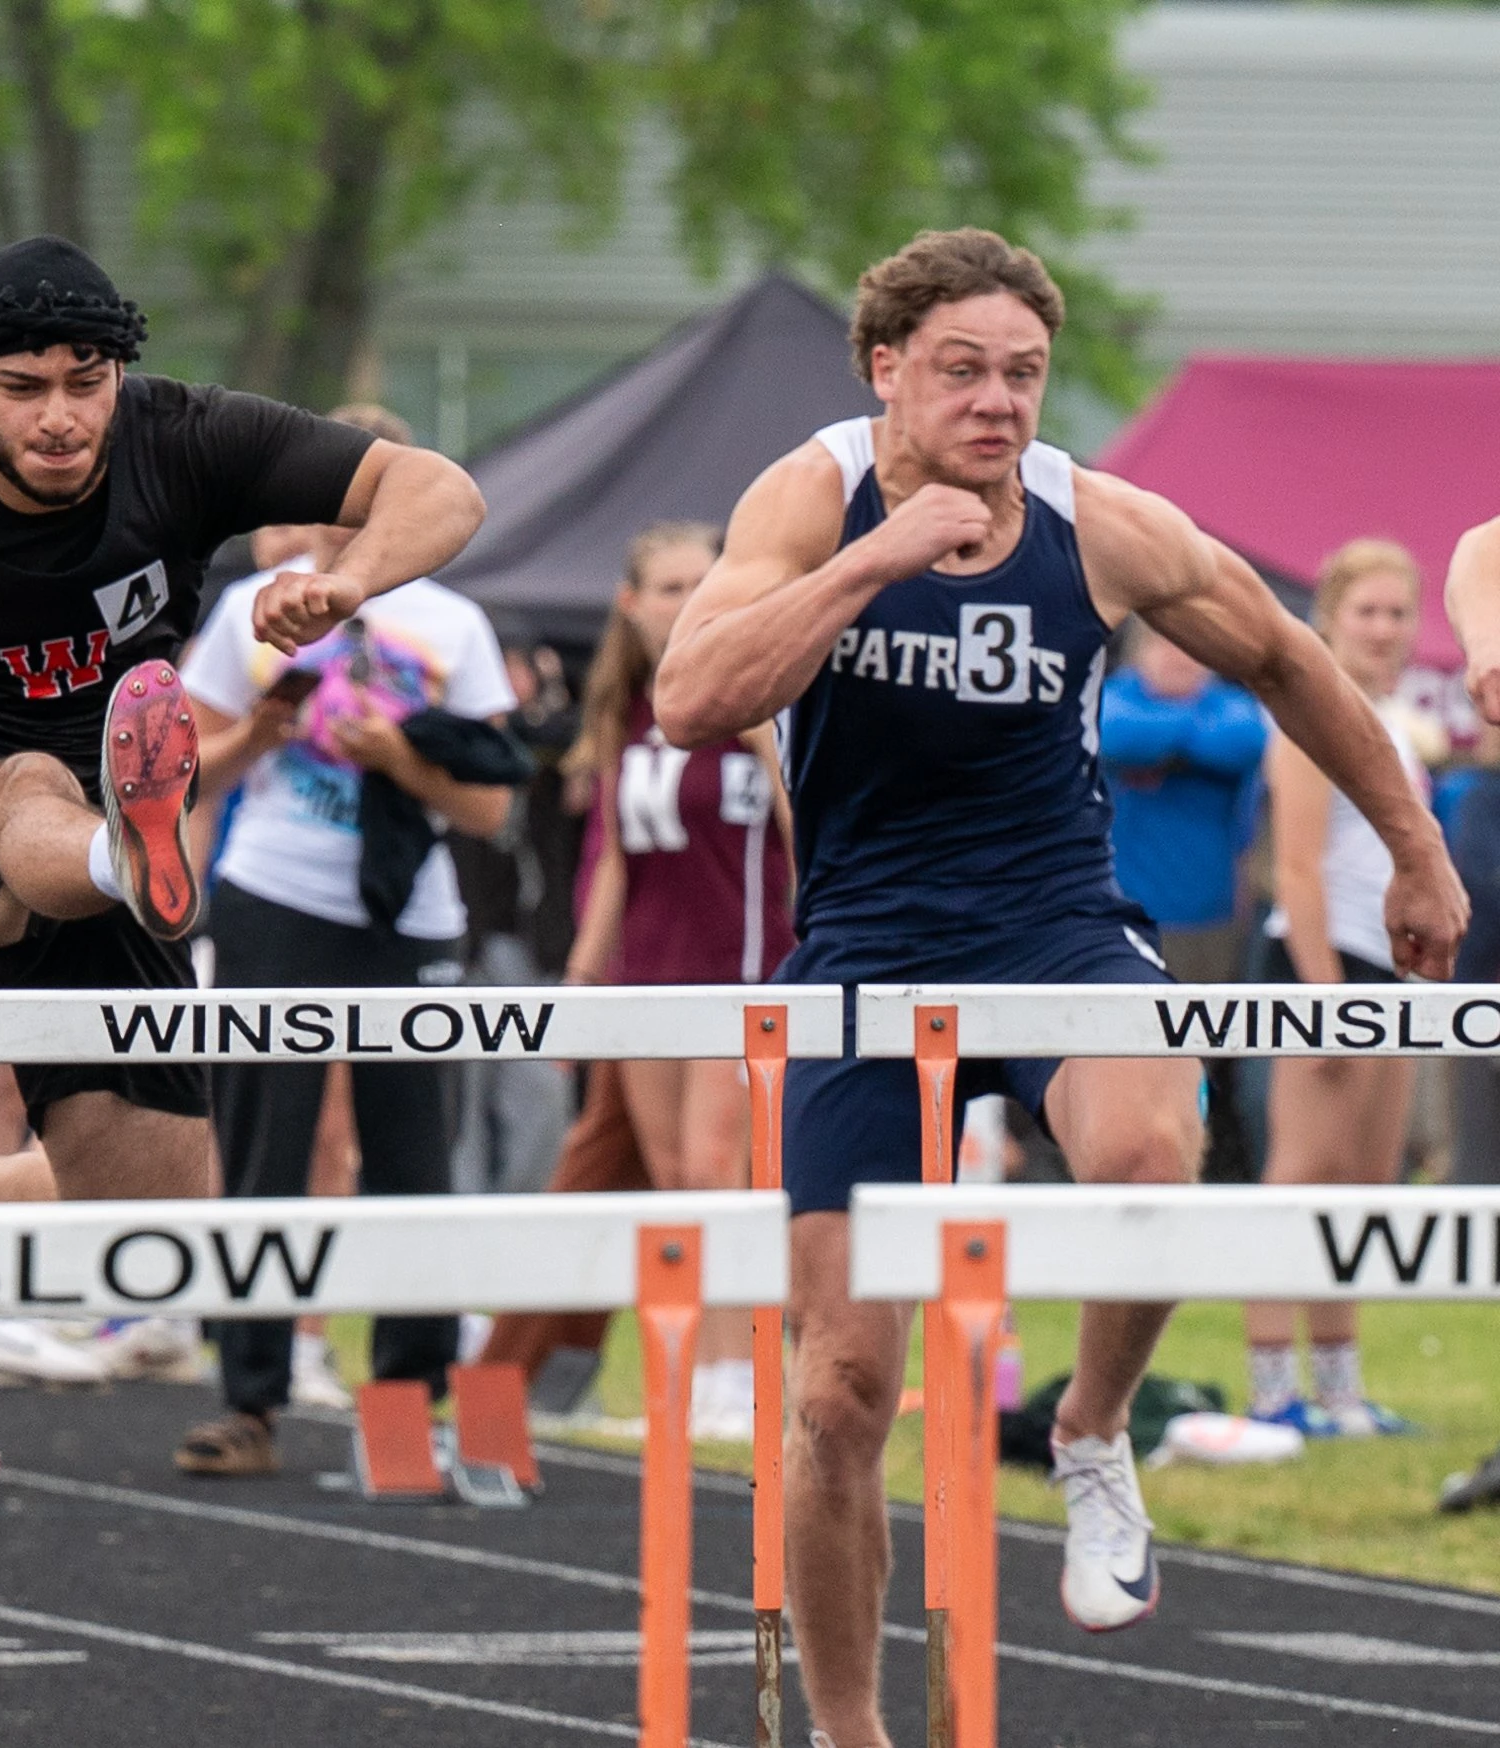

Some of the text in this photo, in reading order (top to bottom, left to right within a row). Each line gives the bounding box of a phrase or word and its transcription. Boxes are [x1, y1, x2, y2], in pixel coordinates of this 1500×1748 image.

[117, 573, 161, 631] 4
[0, 629, 110, 699] W
[969, 612, 1016, 694] 3
[100, 1003, 555, 1053] WINSLOW
[1315, 1211, 1500, 1285] WI
